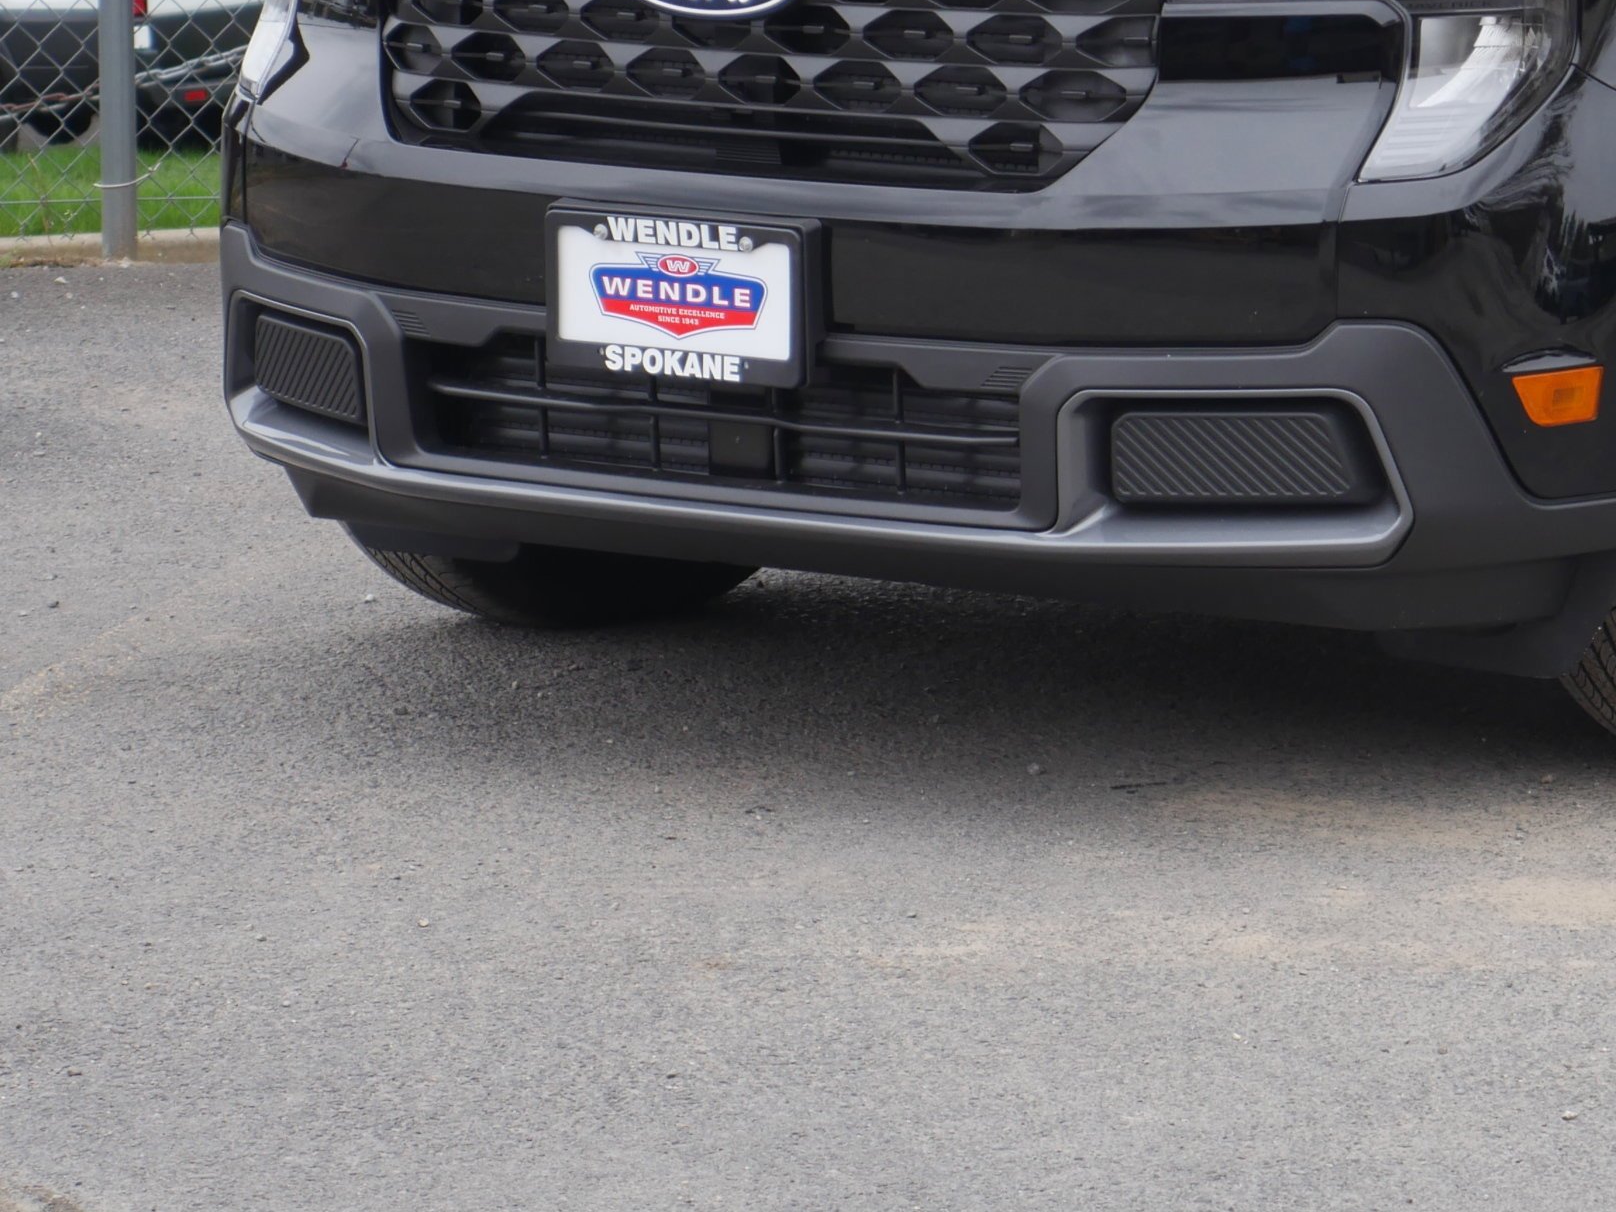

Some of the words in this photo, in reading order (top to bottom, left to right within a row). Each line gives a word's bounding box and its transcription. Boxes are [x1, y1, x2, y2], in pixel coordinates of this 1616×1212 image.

[606, 216, 738, 251] WENDLE
[602, 276, 751, 308] WENDLE
[629, 304, 677, 316] AUTOMOTIVE
[678, 308, 725, 320] EXCELLENCE
[657, 314, 680, 324] SINCE
[681, 316, 700, 326] 1943
[604, 344, 741, 382] SPOKANE
